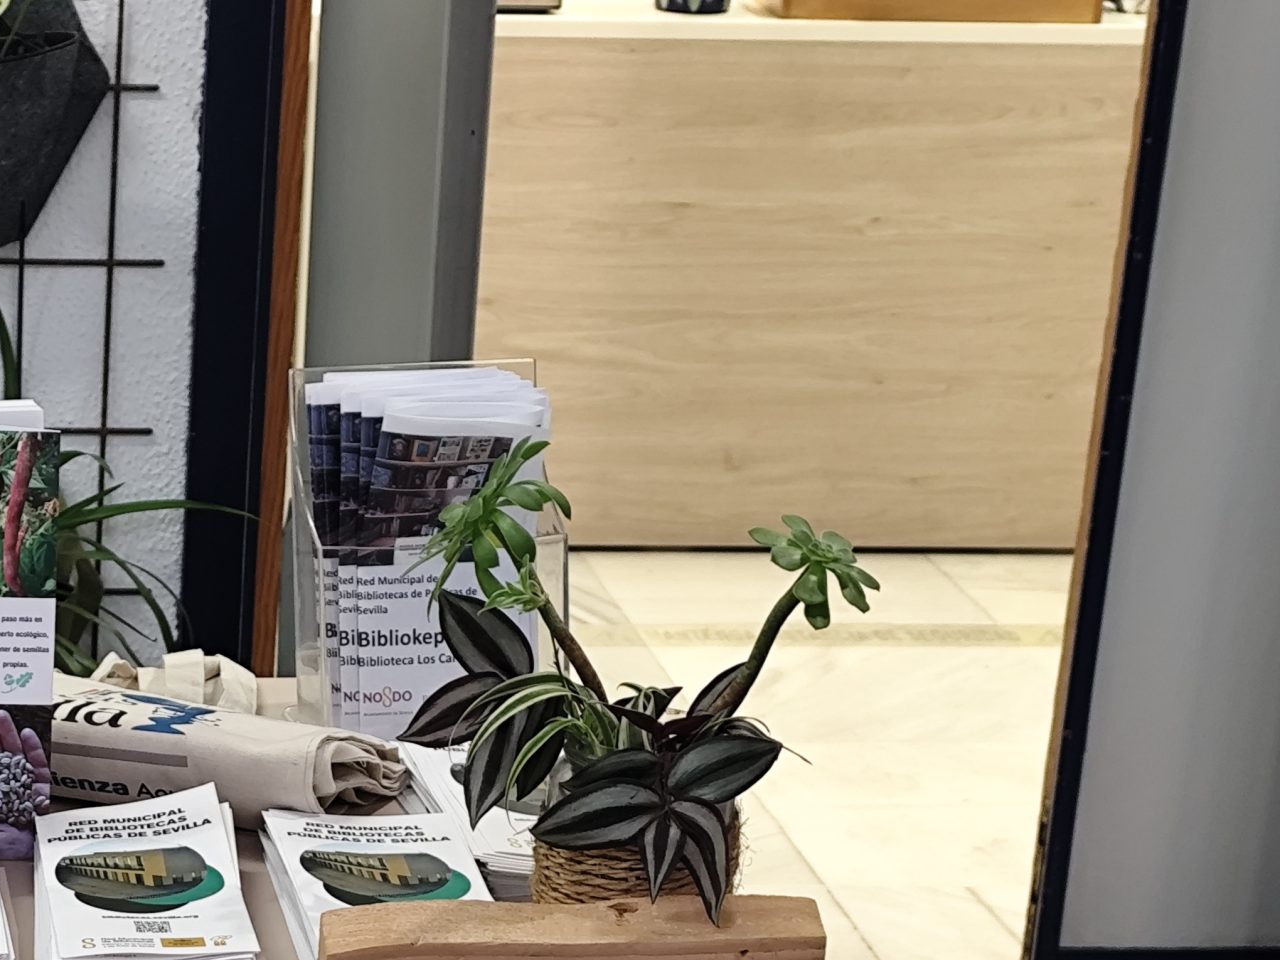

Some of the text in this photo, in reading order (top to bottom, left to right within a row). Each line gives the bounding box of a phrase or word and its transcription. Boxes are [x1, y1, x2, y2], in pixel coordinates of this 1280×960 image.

[357, 574, 438, 587] Red Municipal de
[357, 591, 409, 600] Bibliotecas
[411, 590, 422, 598] de
[465, 587, 478, 596] de
[357, 605, 388, 614] Sevilla
[359, 654, 435, 667] Biblioteca Los
[68, 808, 185, 827] RED MUNICIPAL
[88, 815, 188, 833] BIBLIOTECAS
[47, 833, 123, 843] PÚBLICAS
[152, 818, 213, 837] SEVILLA
[287, 831, 360, 843] PÚBLICAS
[324, 829, 425, 837] BIBLIOTECAS
